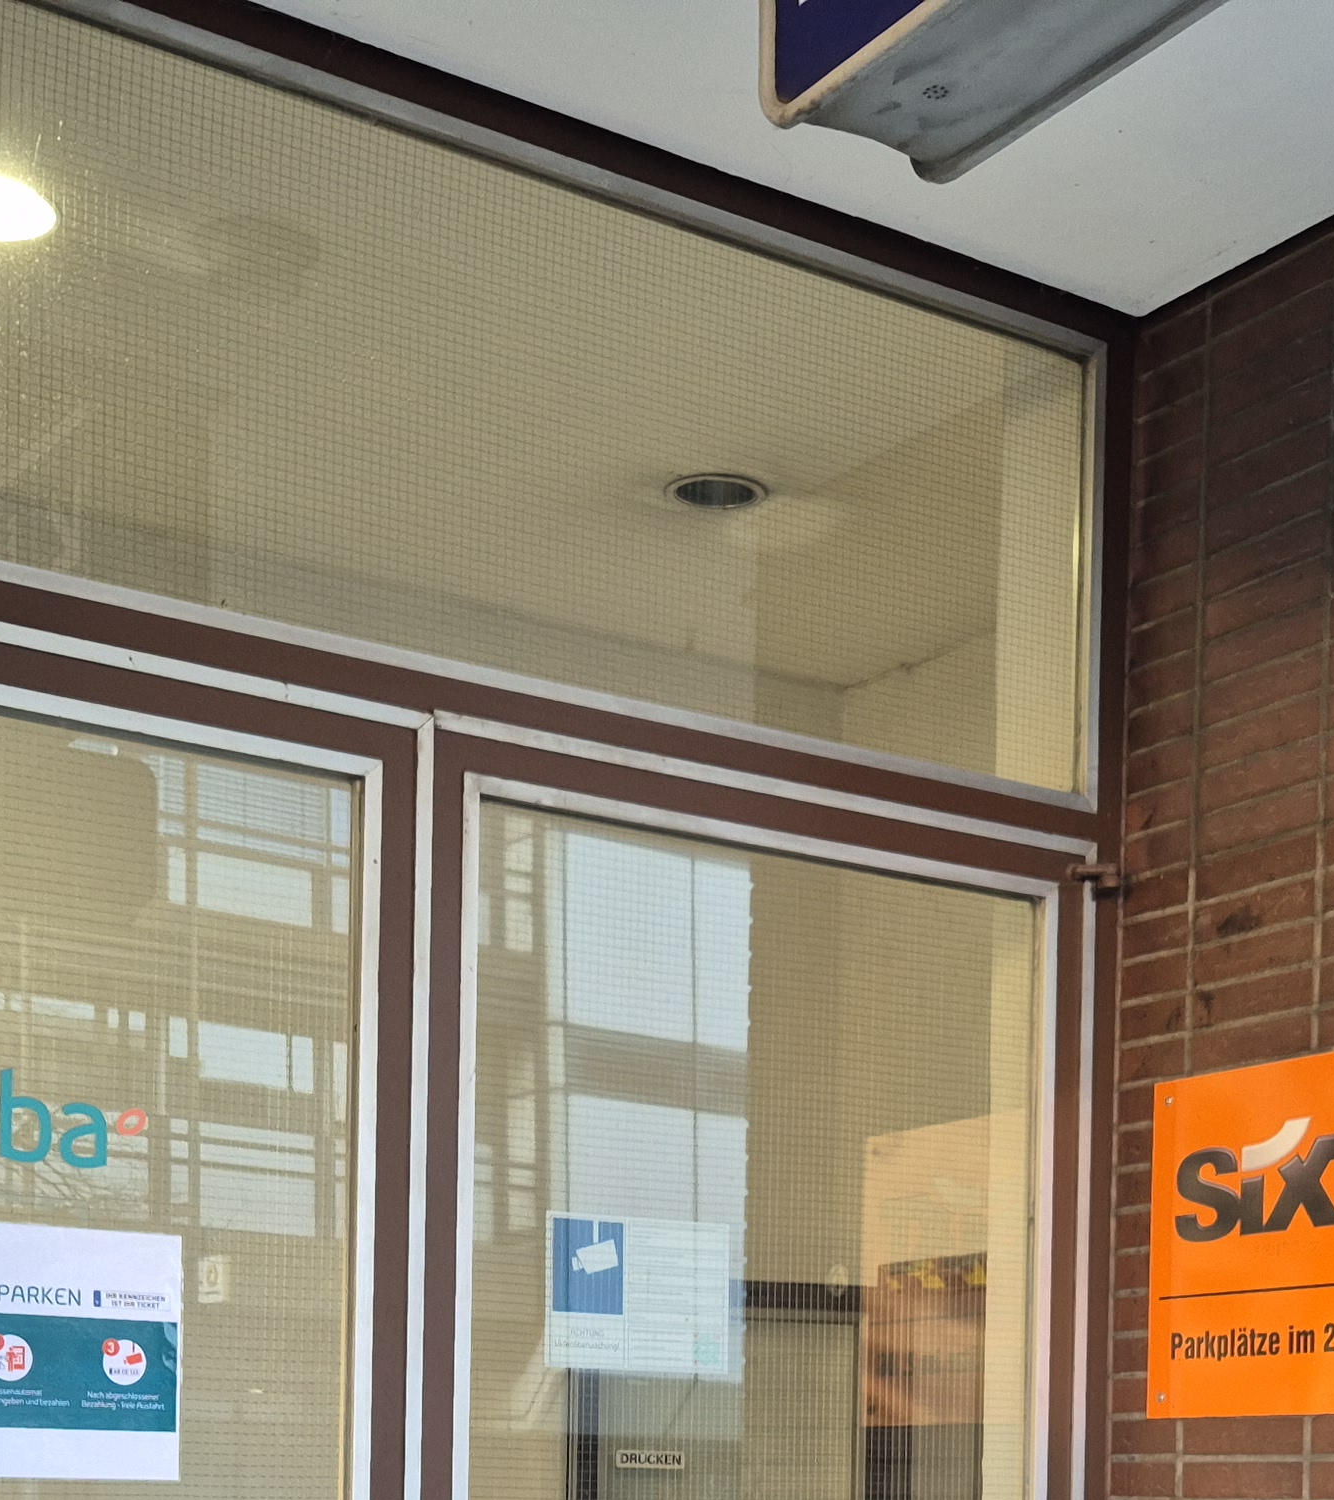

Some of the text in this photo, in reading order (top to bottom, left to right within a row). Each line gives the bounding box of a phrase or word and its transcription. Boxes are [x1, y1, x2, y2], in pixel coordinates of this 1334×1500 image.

[119, 1293, 166, 1302] KENNZEICHEN
[107, 1342, 115, 1354] 3
[1170, 1326, 1280, 1362] Parkplätze
[1288, 1325, 1315, 1354] im
[88, 1391, 105, 1400] Nach
[25, 1397, 39, 1406] und
